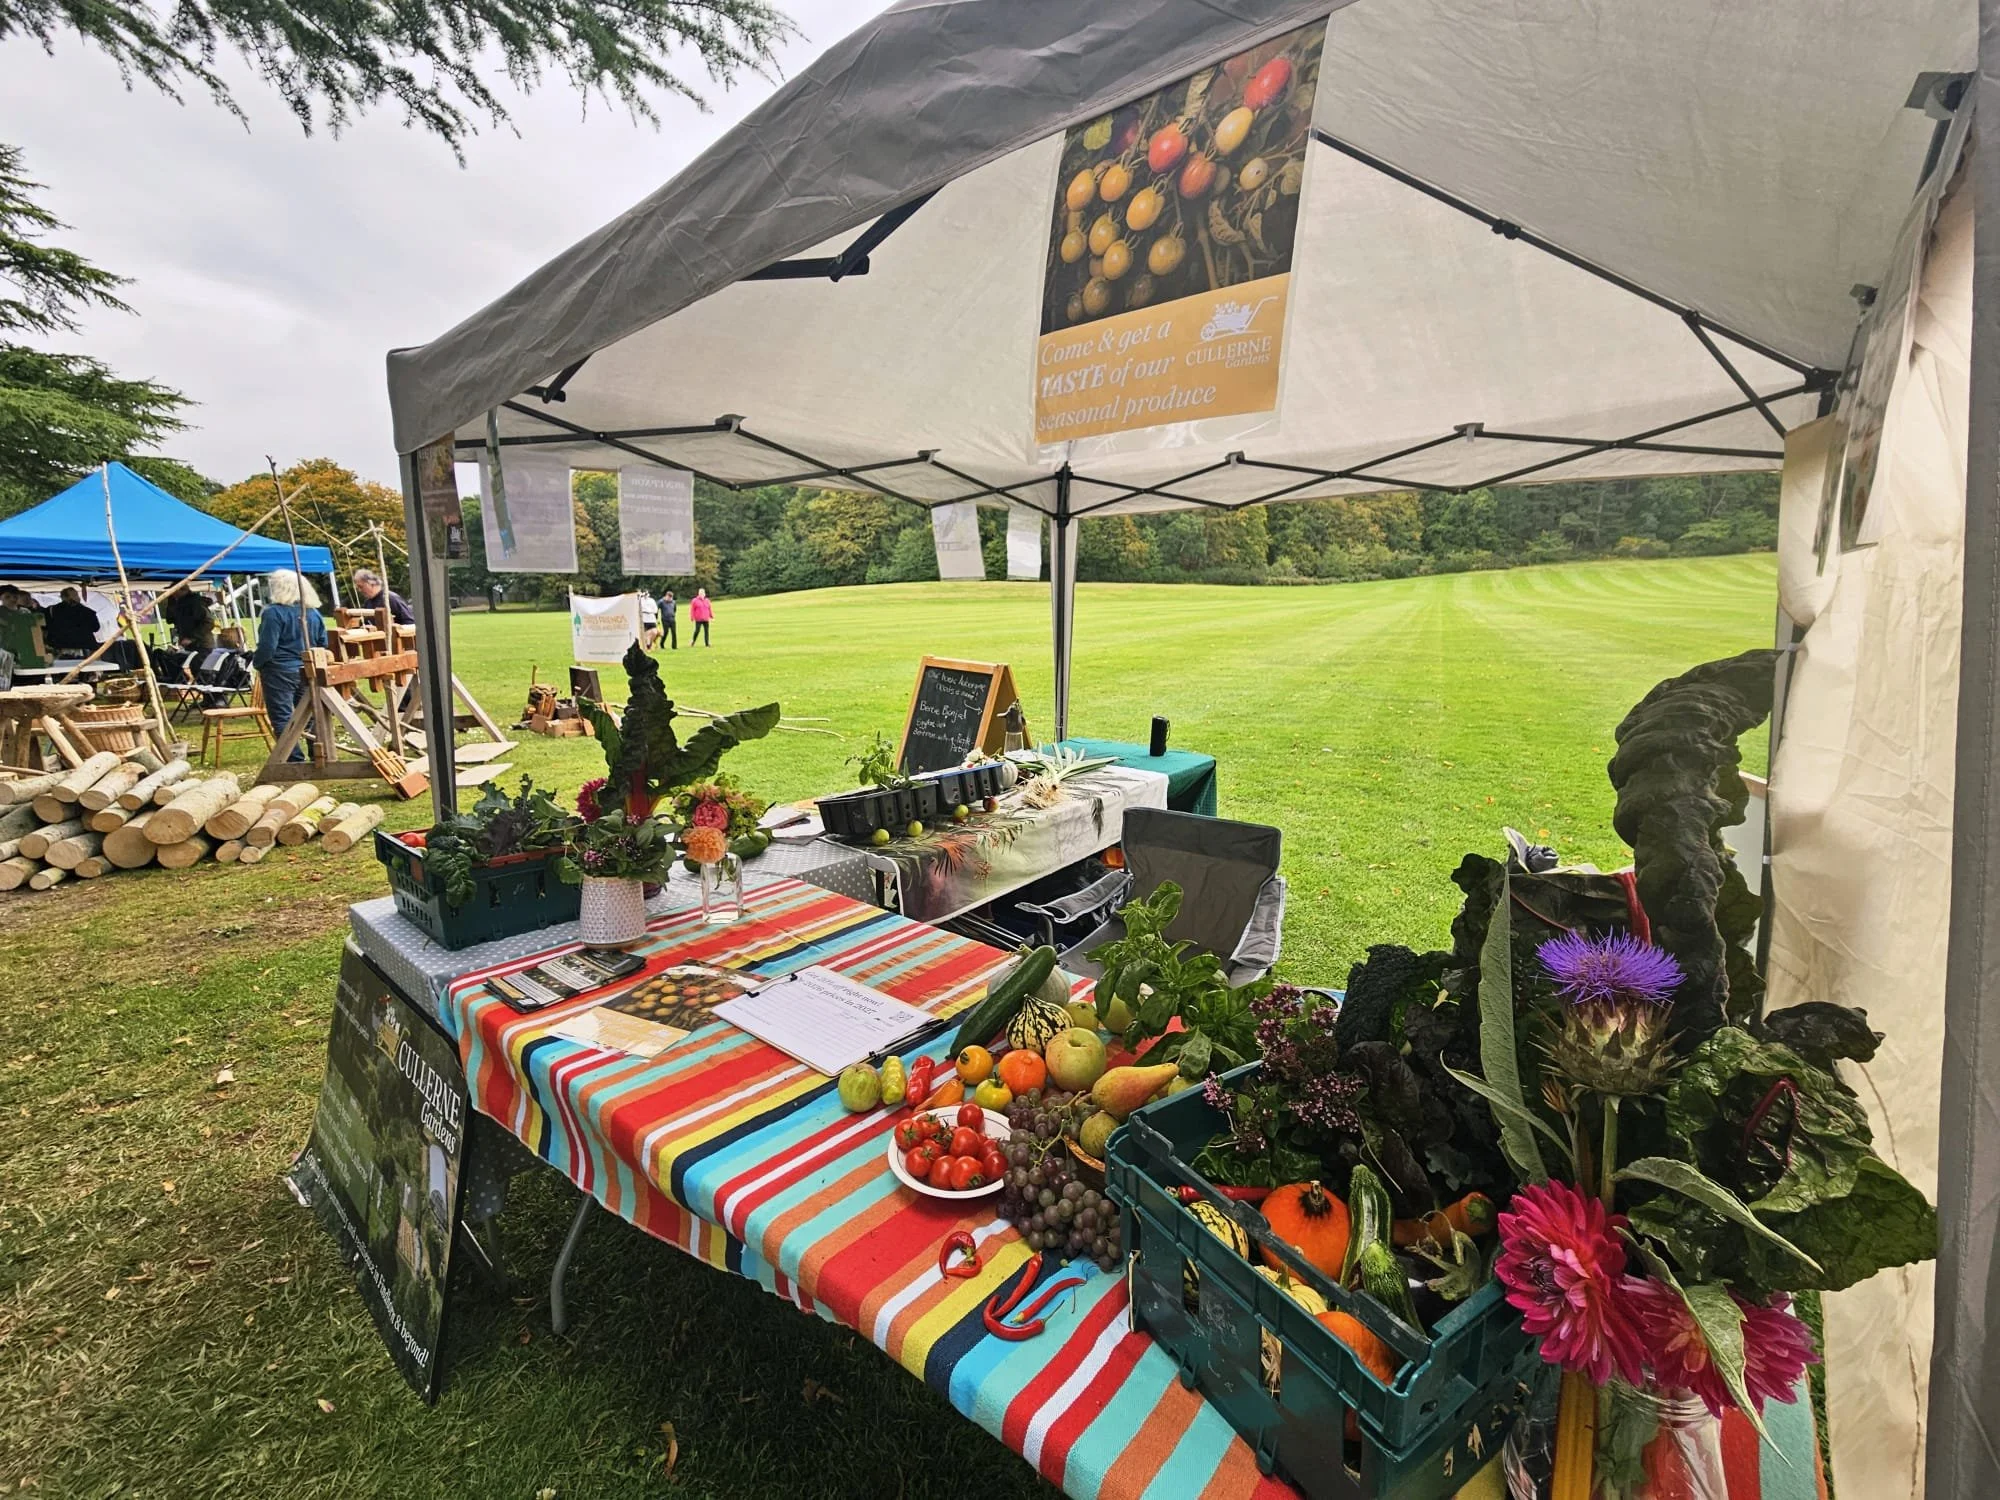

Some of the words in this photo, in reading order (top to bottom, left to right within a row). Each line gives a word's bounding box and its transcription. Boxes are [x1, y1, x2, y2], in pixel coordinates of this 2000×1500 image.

[1040, 339, 1094, 366] Come
[1098, 328, 1115, 353] &
[1118, 324, 1153, 356] get
[1158, 320, 1173, 339] a
[1186, 336, 1273, 367] CULLERNE
[1225, 352, 1271, 369] Gardens
[1040, 363, 1107, 398] TASTE
[1110, 359, 1132, 387] of
[1134, 355, 1175, 378] our
[1038, 396, 1120, 432] seasonal
[1122, 383, 1217, 423] produce
[820, 989, 845, 1002] prices
[842, 987, 863, 999] right
[398, 1040, 461, 1130] CULLERNE
[420, 1101, 457, 1154] Gardens
[328, 1186, 349, 1230] community
[346, 1222, 357, 1239] and
[373, 1264, 381, 1289] in
[378, 1273, 396, 1325] Findhorn
[394, 1314, 402, 1333] &
[400, 1321, 429, 1369] beyond!
